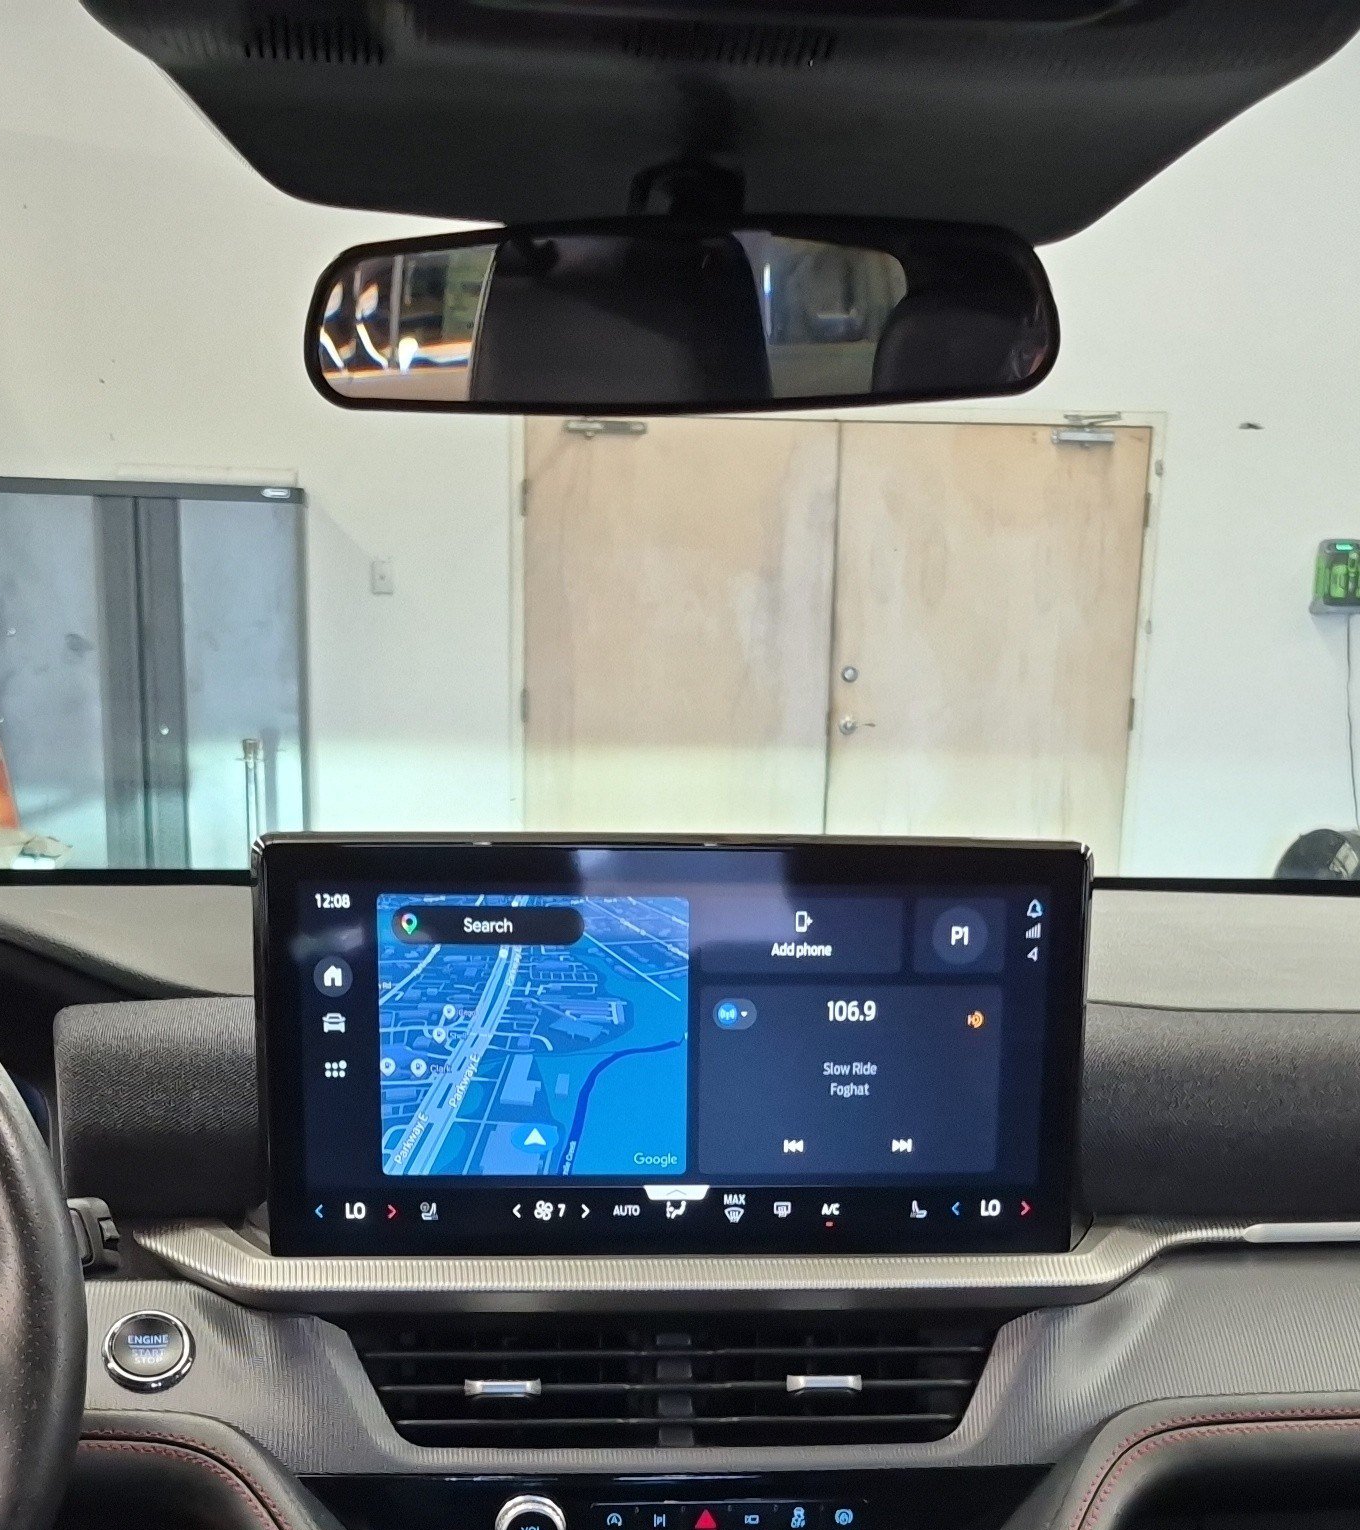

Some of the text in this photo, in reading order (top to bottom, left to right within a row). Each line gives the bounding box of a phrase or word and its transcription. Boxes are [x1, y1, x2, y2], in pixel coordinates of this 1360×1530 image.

[315, 893, 351, 909] 12:08
[463, 917, 513, 933] Search
[950, 925, 969, 945] P1
[771, 943, 833, 958] Add phone
[827, 1000, 876, 1022] 106.9
[822, 1062, 878, 1076] Slow Ride
[448, 1063, 477, 1108] Parkway
[830, 1083, 869, 1098] Foghat
[394, 1120, 426, 1165] Parkway
[633, 1152, 678, 1168] Google
[723, 1194, 746, 1205] MAX
[345, 1201, 366, 1219] LO
[557, 1203, 566, 1218] 7
[613, 1204, 640, 1216] AUTO
[821, 1203, 840, 1216] A/C
[980, 1199, 1001, 1216] LO
[127, 1334, 169, 1344] ENGINE
[131, 1348, 166, 1357] START
